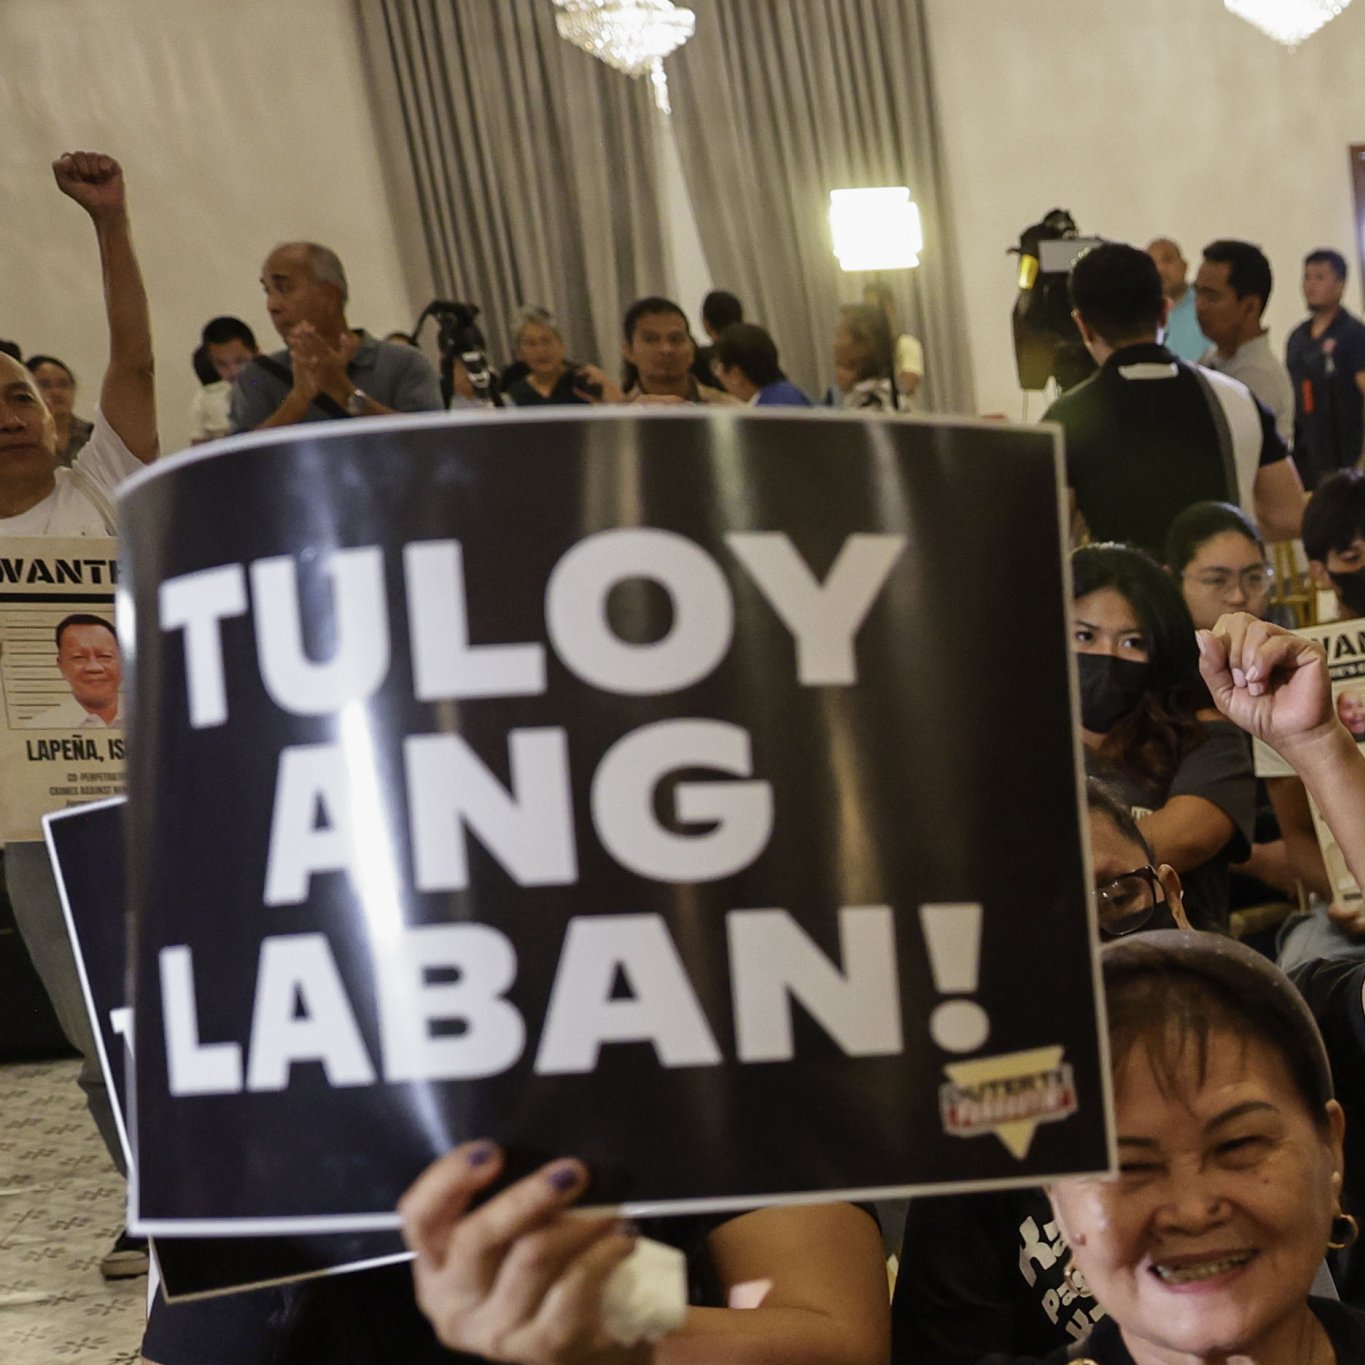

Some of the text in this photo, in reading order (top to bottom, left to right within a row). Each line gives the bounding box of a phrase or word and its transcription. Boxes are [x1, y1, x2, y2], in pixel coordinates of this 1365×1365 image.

[160, 527, 906, 728] TULOY
[26, 734, 104, 762] LAPEÑA,
[264, 718, 773, 906] ANG
[160, 904, 990, 1098] LABAN!
